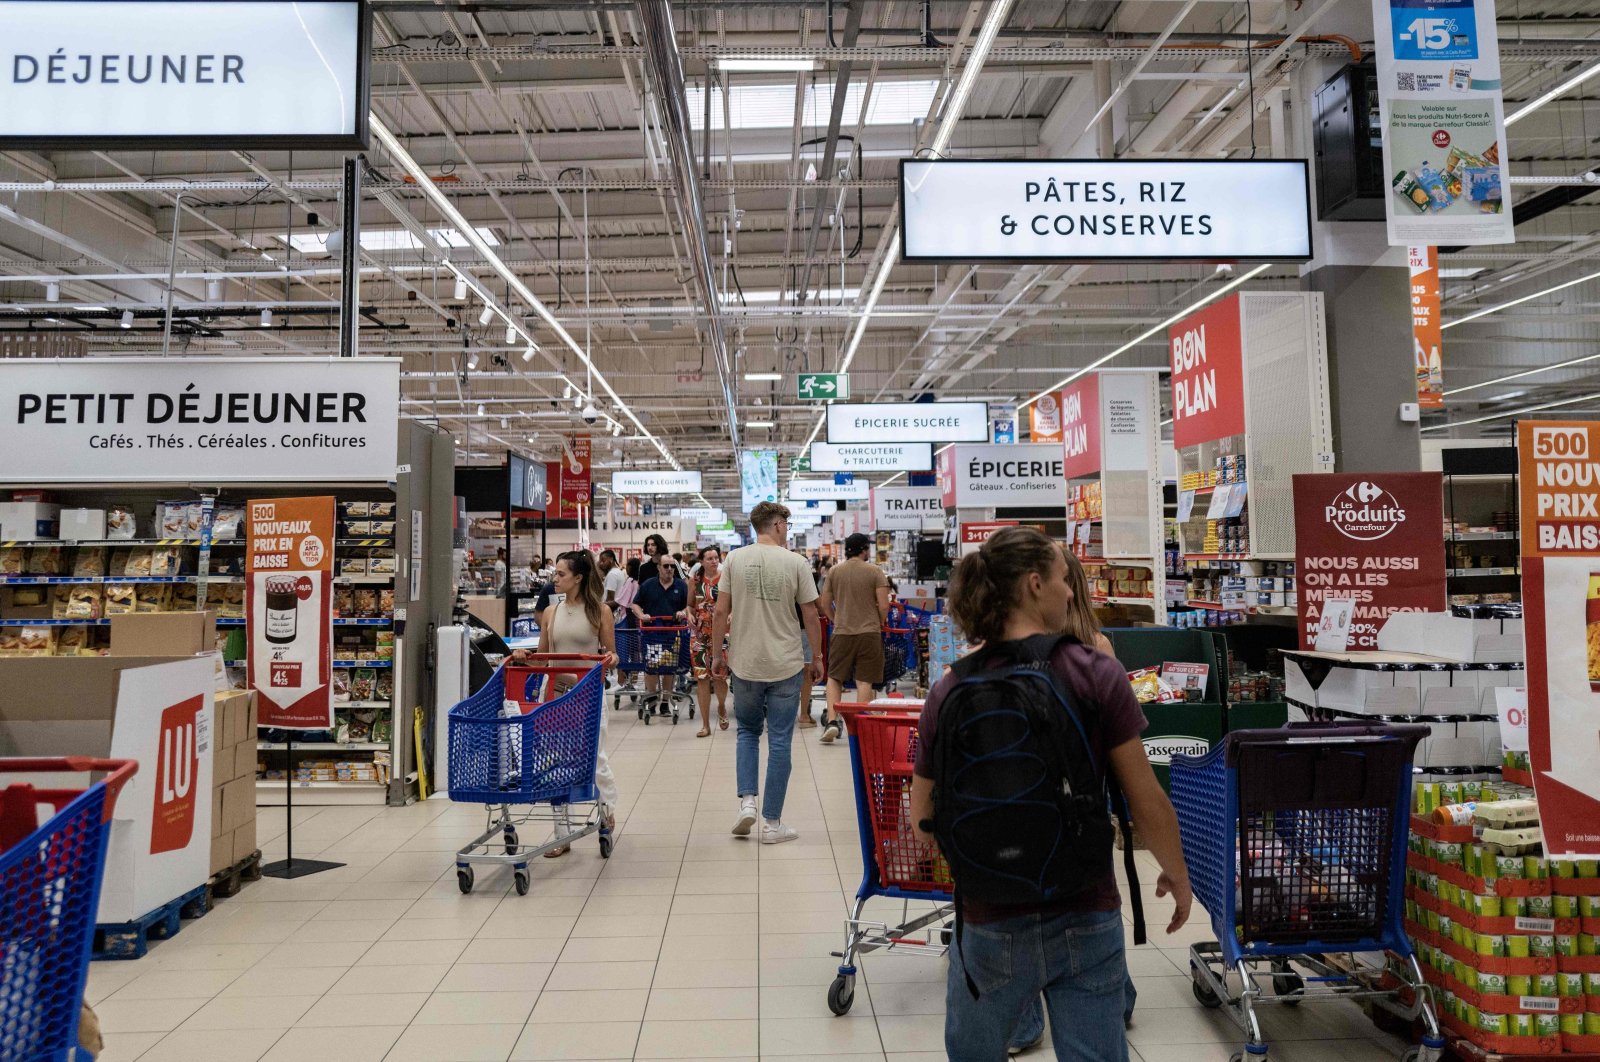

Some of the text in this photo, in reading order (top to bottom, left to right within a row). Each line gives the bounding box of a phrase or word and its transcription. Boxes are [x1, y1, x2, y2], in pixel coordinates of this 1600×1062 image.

[1400, 18, 1458, 50] -15%
[13, 48, 246, 84] DÉJEUNER
[1026, 176, 1186, 205] PÂTES, RIZ
[1000, 214, 1213, 236] & CONSERVES
[1173, 324, 1206, 375] BON
[1175, 368, 1217, 420] PLAN
[18, 384, 366, 424] PETIT DÉJEUNER
[1064, 391, 1081, 426] BON
[855, 417, 960, 428] ÉPICERIE SUCRÉE
[89, 433, 366, 449] Cafés Thés Céréales Confitures
[1064, 424, 1087, 458] PLAN
[1537, 432, 1586, 456] 500
[970, 457, 1063, 478] ÉPICERIE
[970, 482, 1056, 491] Gâteaux Confiseries
[254, 507, 274, 519] 500
[1325, 505, 1406, 523] Produits
[1538, 493, 1598, 517] PRIX
[254, 521, 311, 535] NOUVEAUX
[254, 538, 293, 551] PRIX EN
[254, 555, 288, 568] BAISSE
[1305, 557, 1419, 570] NOUS AUSSI
[1305, 573, 1388, 586] ON A LES
[1306, 586, 1373, 602] MÊMES
[1306, 603, 1319, 618] À
[163, 723, 192, 804] LU
[1565, 834, 1575, 842] Soit
